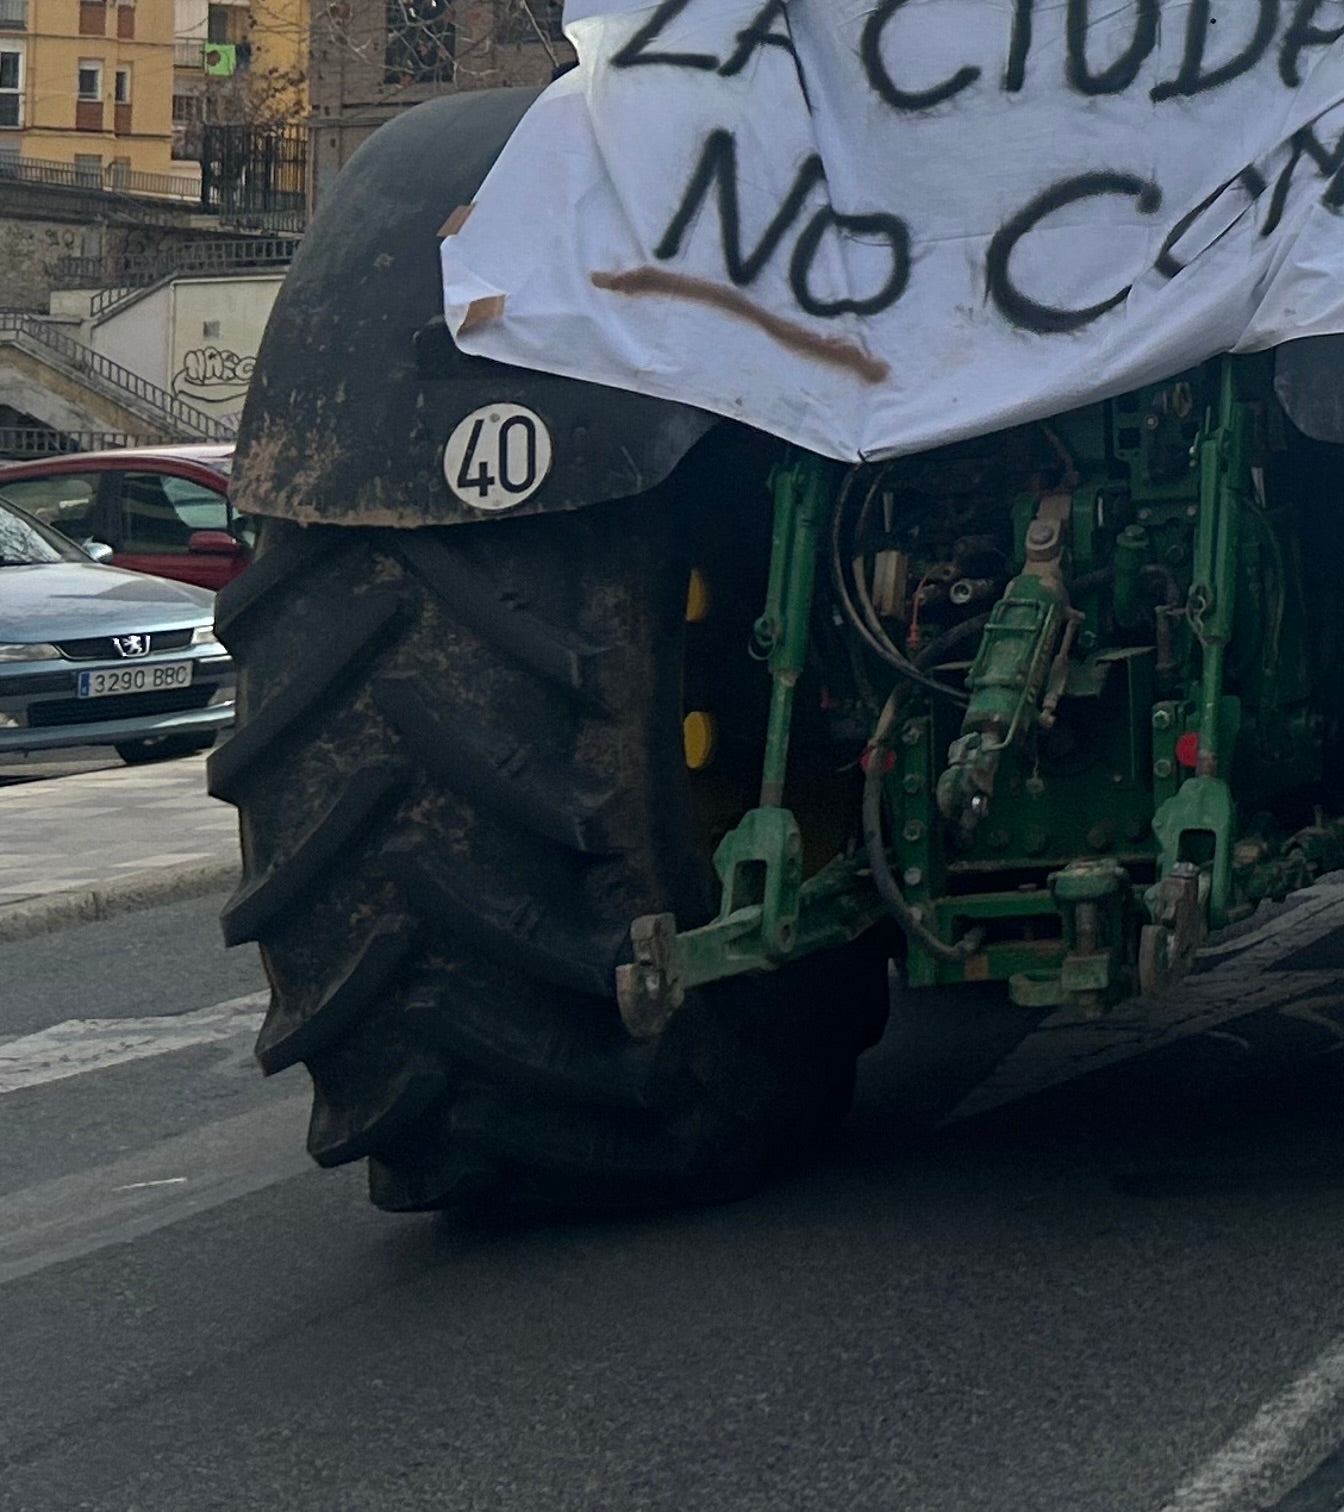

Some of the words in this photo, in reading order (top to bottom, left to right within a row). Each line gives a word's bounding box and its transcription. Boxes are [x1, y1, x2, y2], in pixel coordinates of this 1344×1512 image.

[653, 125, 911, 319] NO
[456, 414, 538, 498] 40
[95, 669, 145, 693] 3290
[153, 665, 187, 687] BBC
